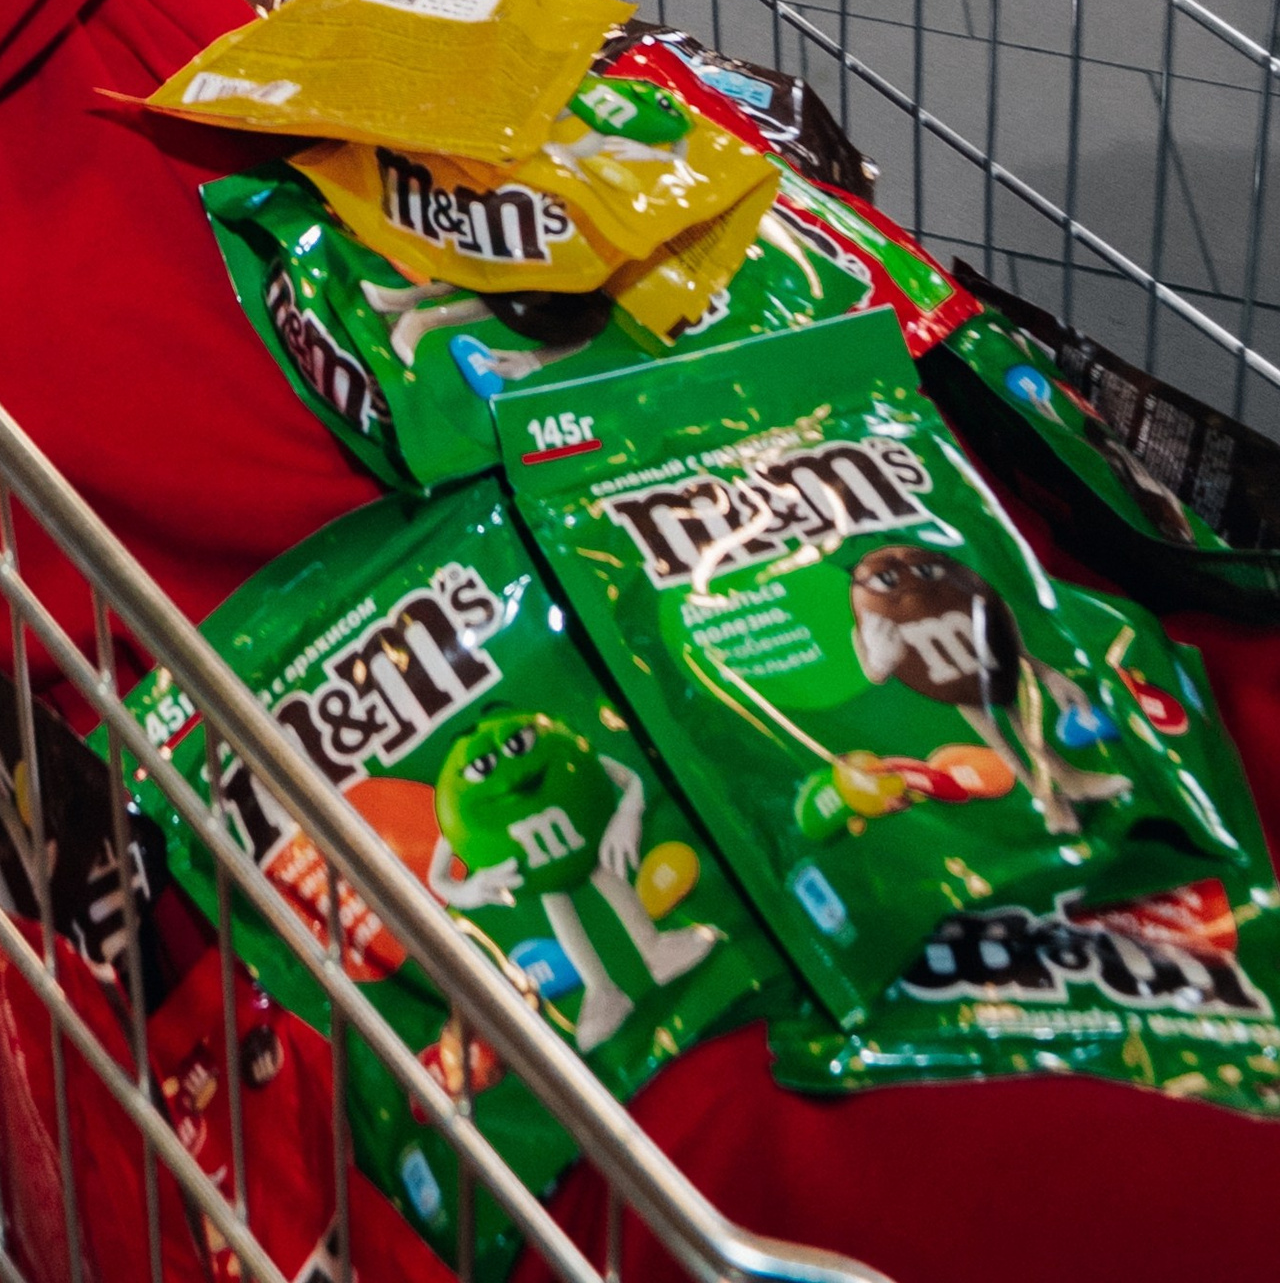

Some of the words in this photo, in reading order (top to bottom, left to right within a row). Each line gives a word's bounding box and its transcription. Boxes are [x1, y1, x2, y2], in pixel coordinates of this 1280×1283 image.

[375, 146, 576, 265] m&m's
[527, 412, 595, 452] 145г
[590, 458, 686, 496] солёный
[686, 455, 700, 471] с
[285, 596, 379, 683] арахисом
[693, 608, 792, 646] полезно.
